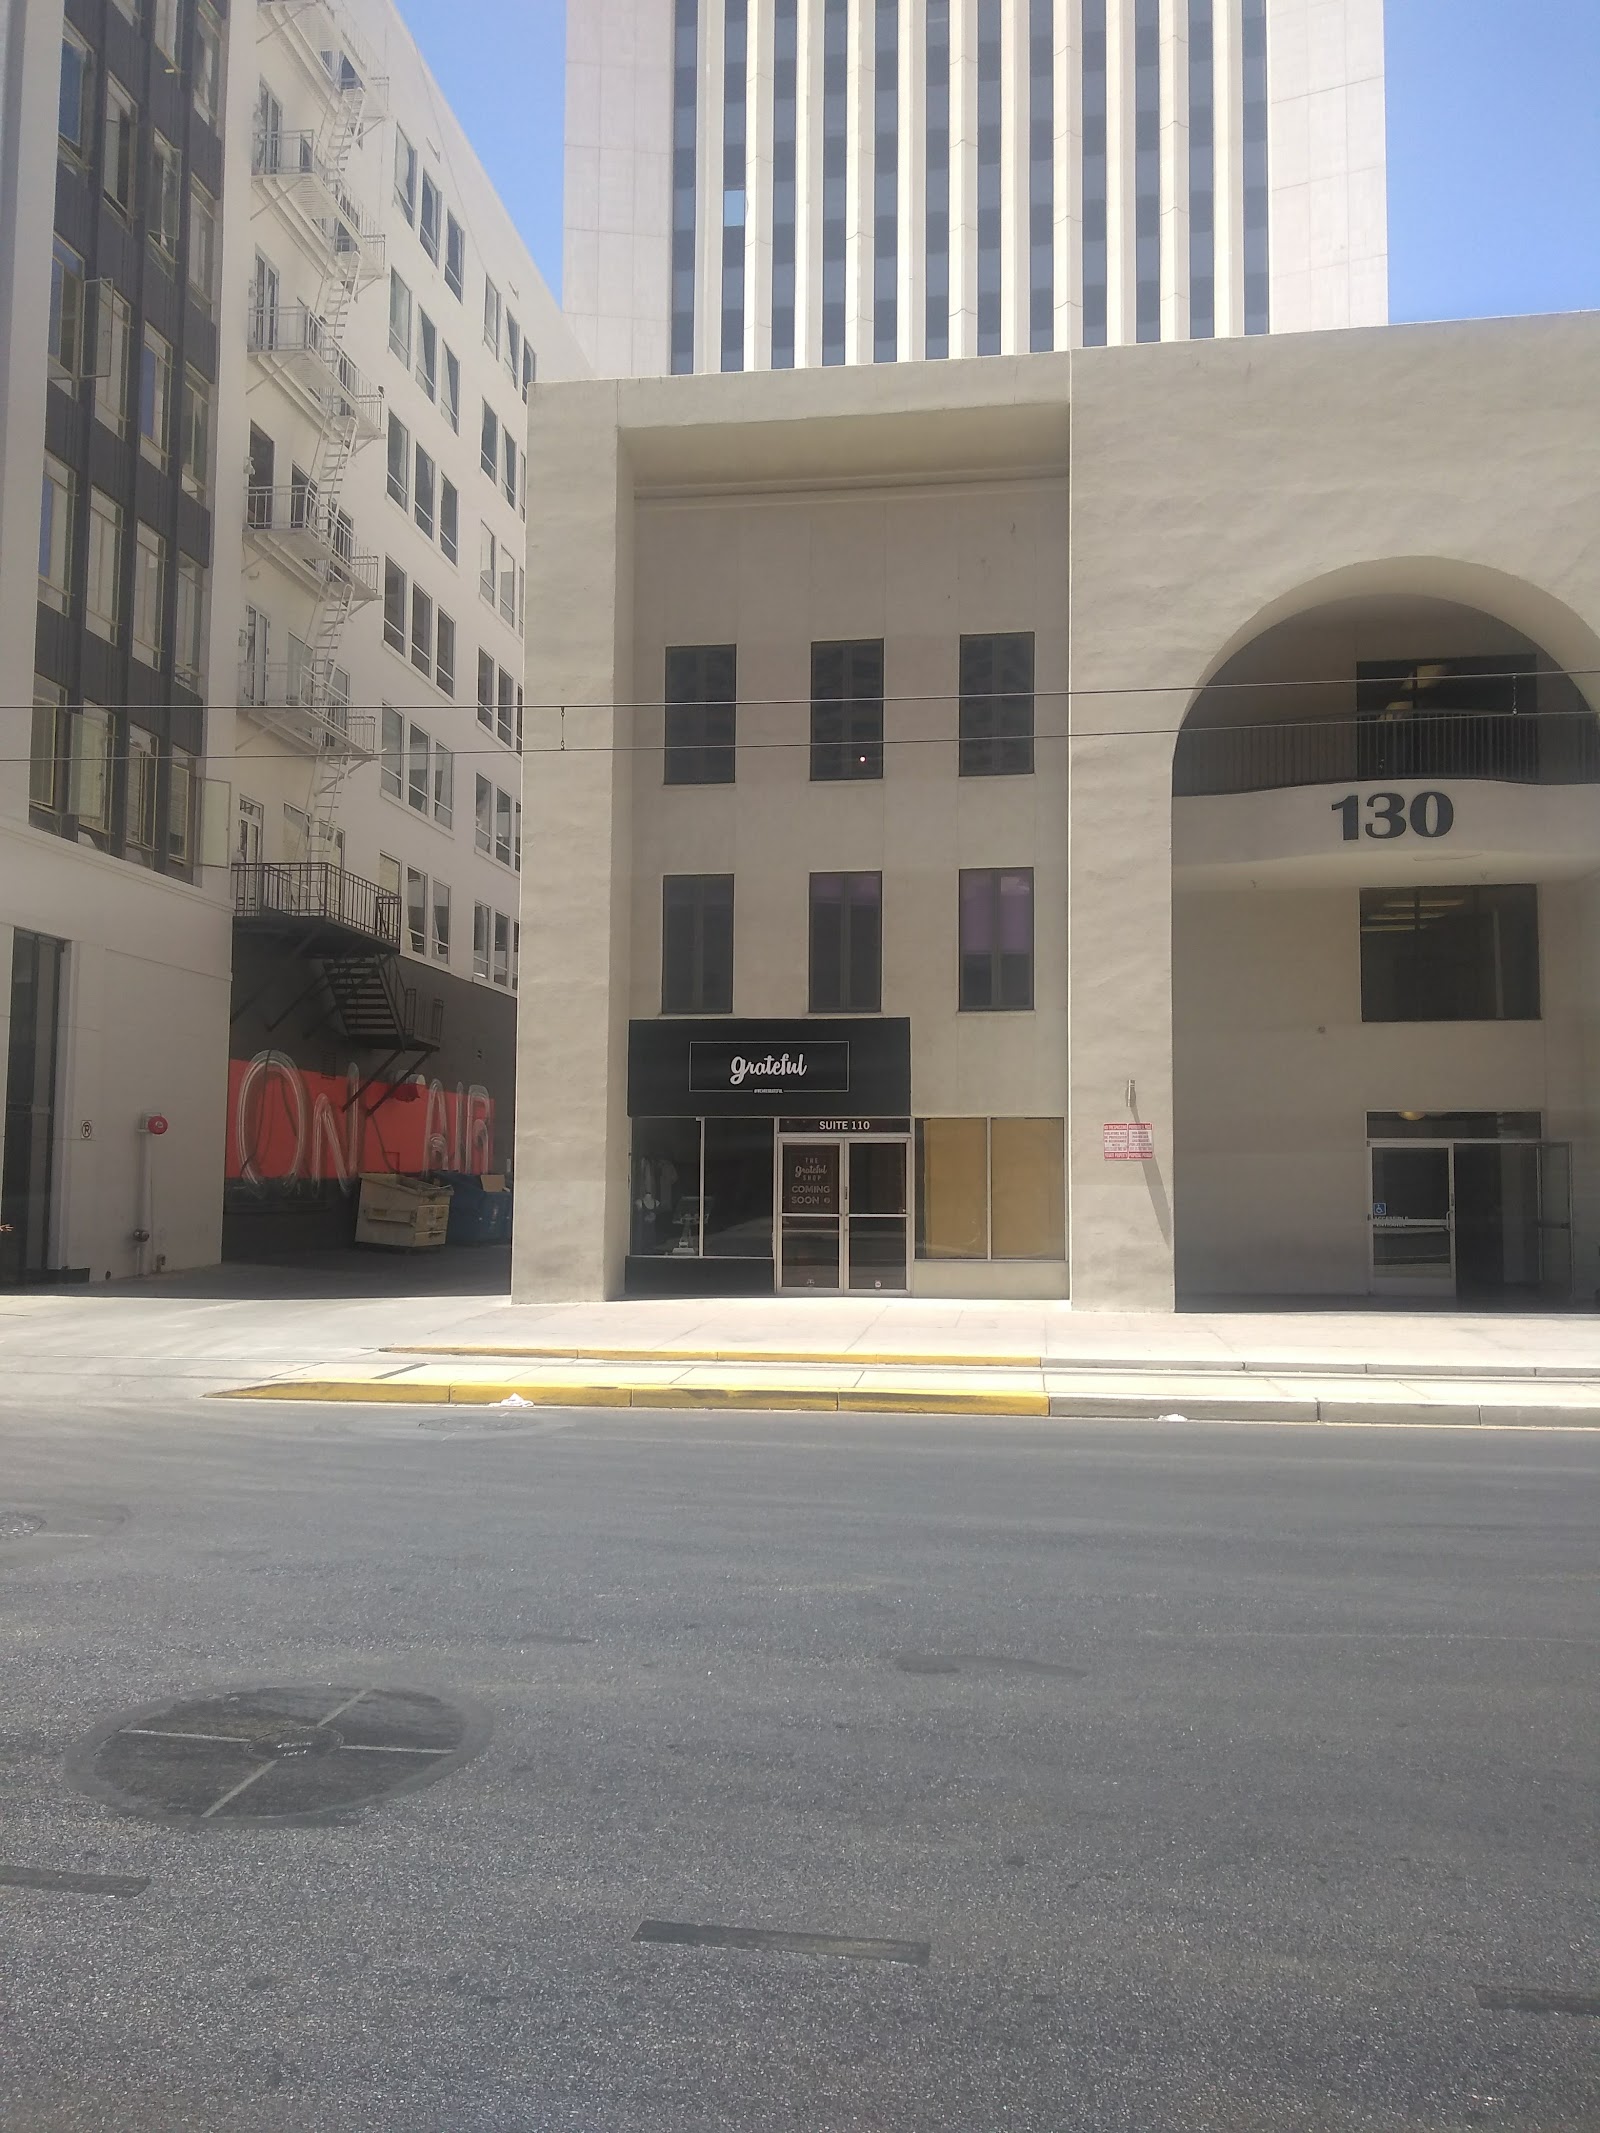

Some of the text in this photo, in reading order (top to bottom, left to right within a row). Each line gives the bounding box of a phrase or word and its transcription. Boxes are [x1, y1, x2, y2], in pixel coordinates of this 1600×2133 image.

[1331, 791, 1454, 841] 130
[729, 1052, 808, 1086] grateful
[236, 1049, 491, 1199] ON AIR
[819, 1120, 870, 1130] SUITE 110
[791, 1185, 830, 1194] COMING
[791, 1196, 820, 1205] SOON
